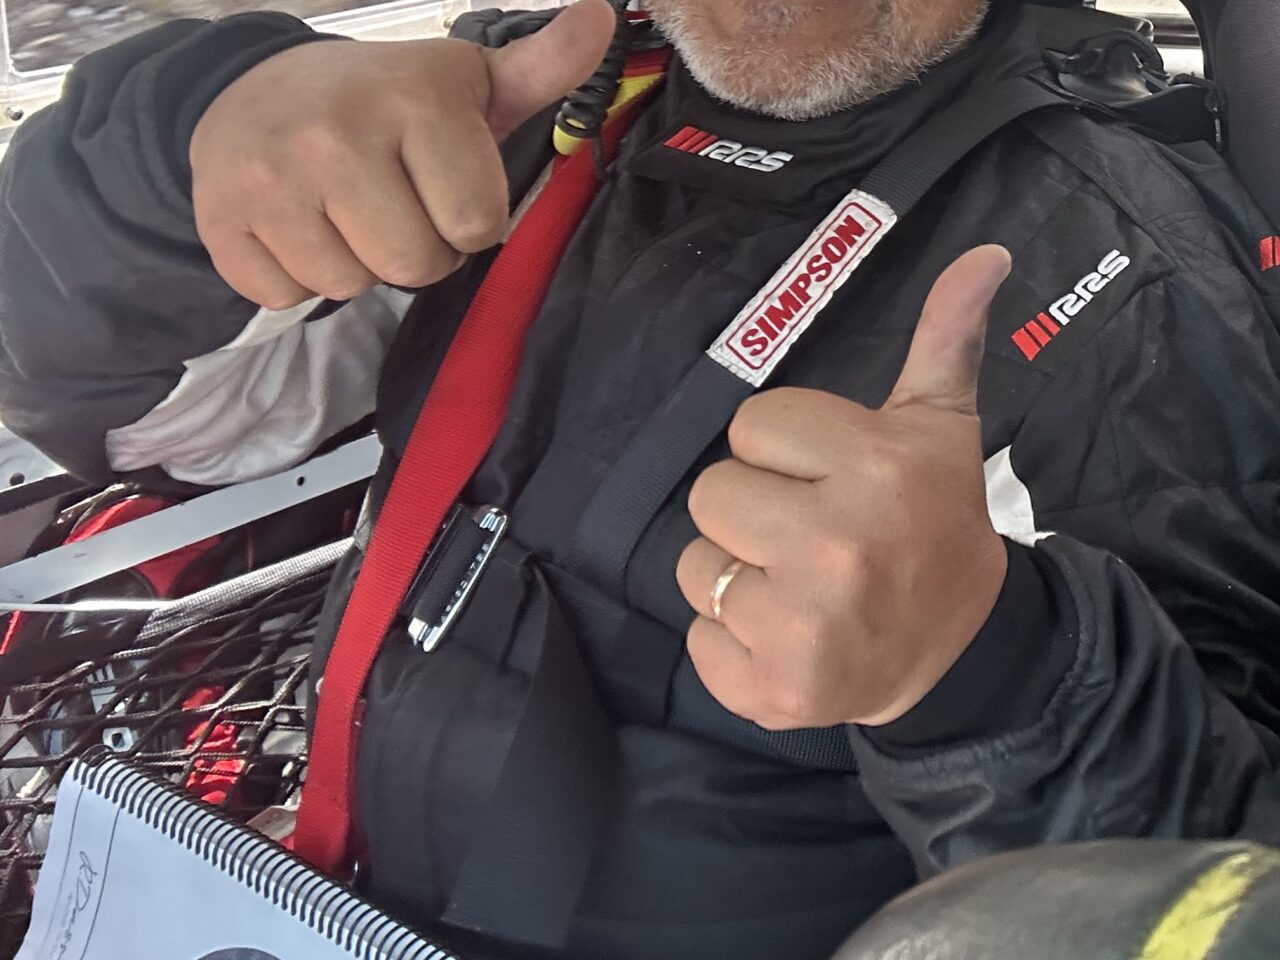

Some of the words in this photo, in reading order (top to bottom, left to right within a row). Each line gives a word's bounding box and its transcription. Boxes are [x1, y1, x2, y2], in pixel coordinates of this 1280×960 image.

[698, 139, 793, 174] RRS
[740, 215, 866, 358] SIMPSON
[1048, 248, 1130, 327] RRS
